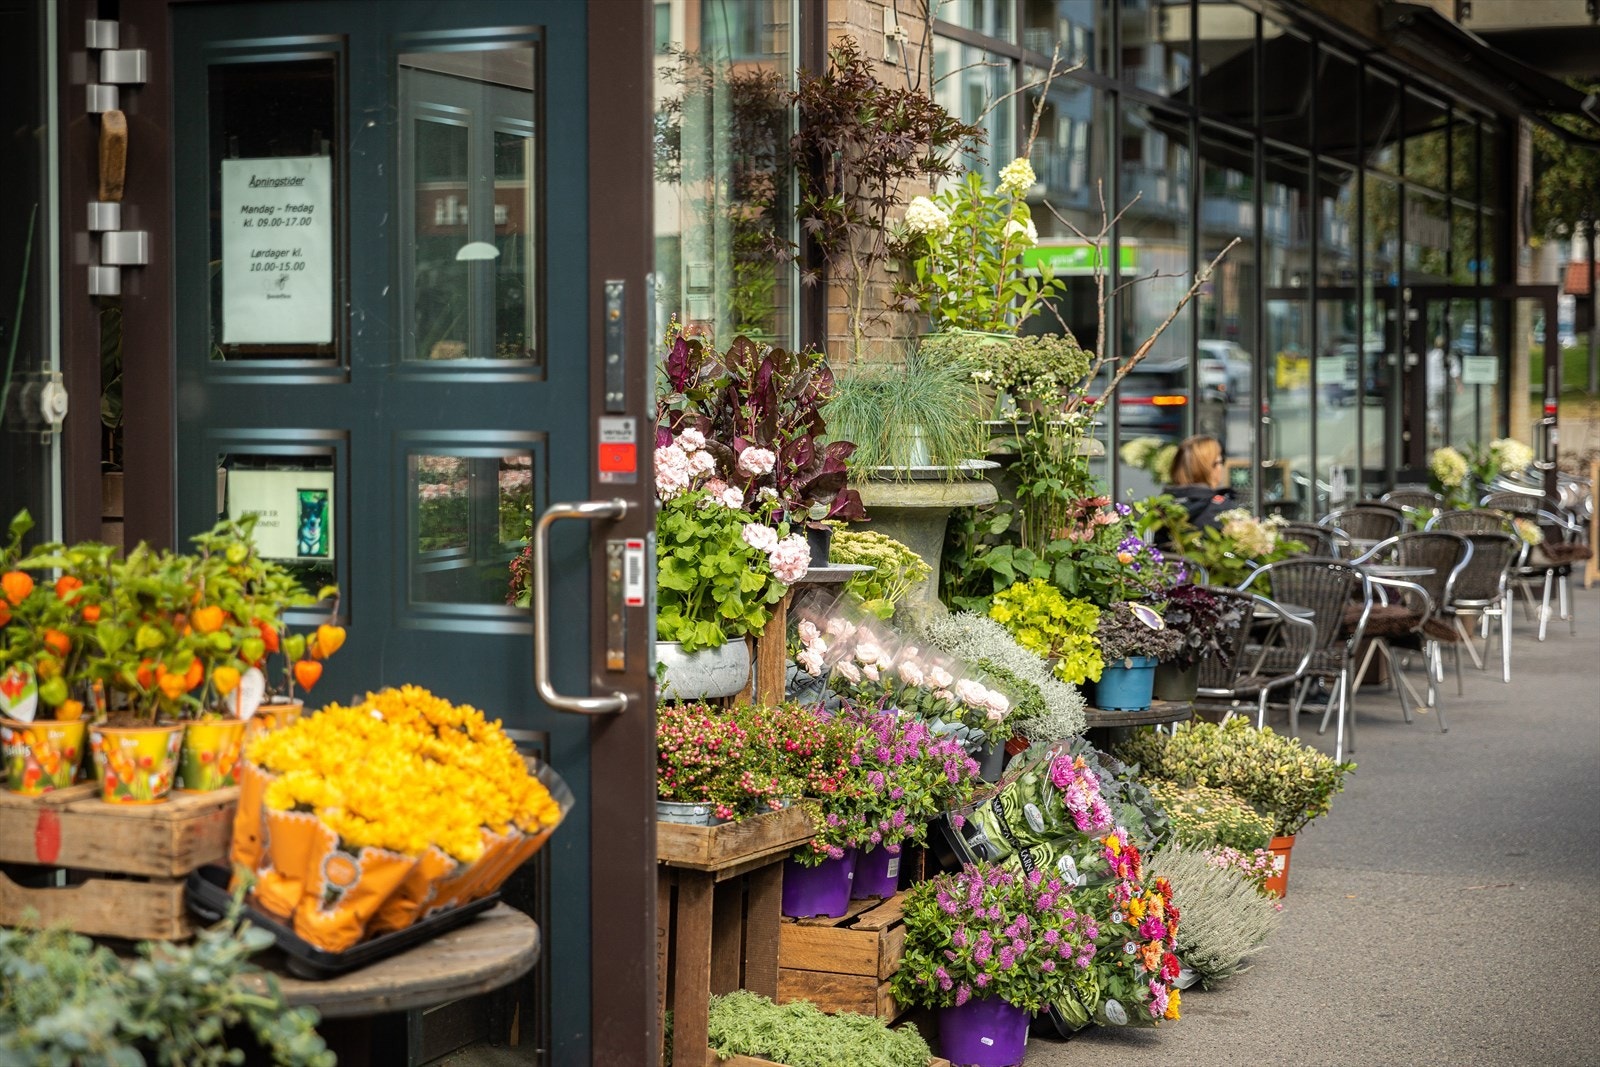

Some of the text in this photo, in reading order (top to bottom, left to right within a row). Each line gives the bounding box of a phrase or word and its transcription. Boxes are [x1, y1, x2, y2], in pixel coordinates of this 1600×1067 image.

[248, 174, 305, 188] Åpningstider
[240, 204, 275, 215] Mandag
[284, 203, 314, 214] fredag
[243, 217, 312, 227] kl. 09.00-17.00
[251, 248, 303, 259] Lørdager kl.
[250, 262, 306, 271] 10.00-15.00
